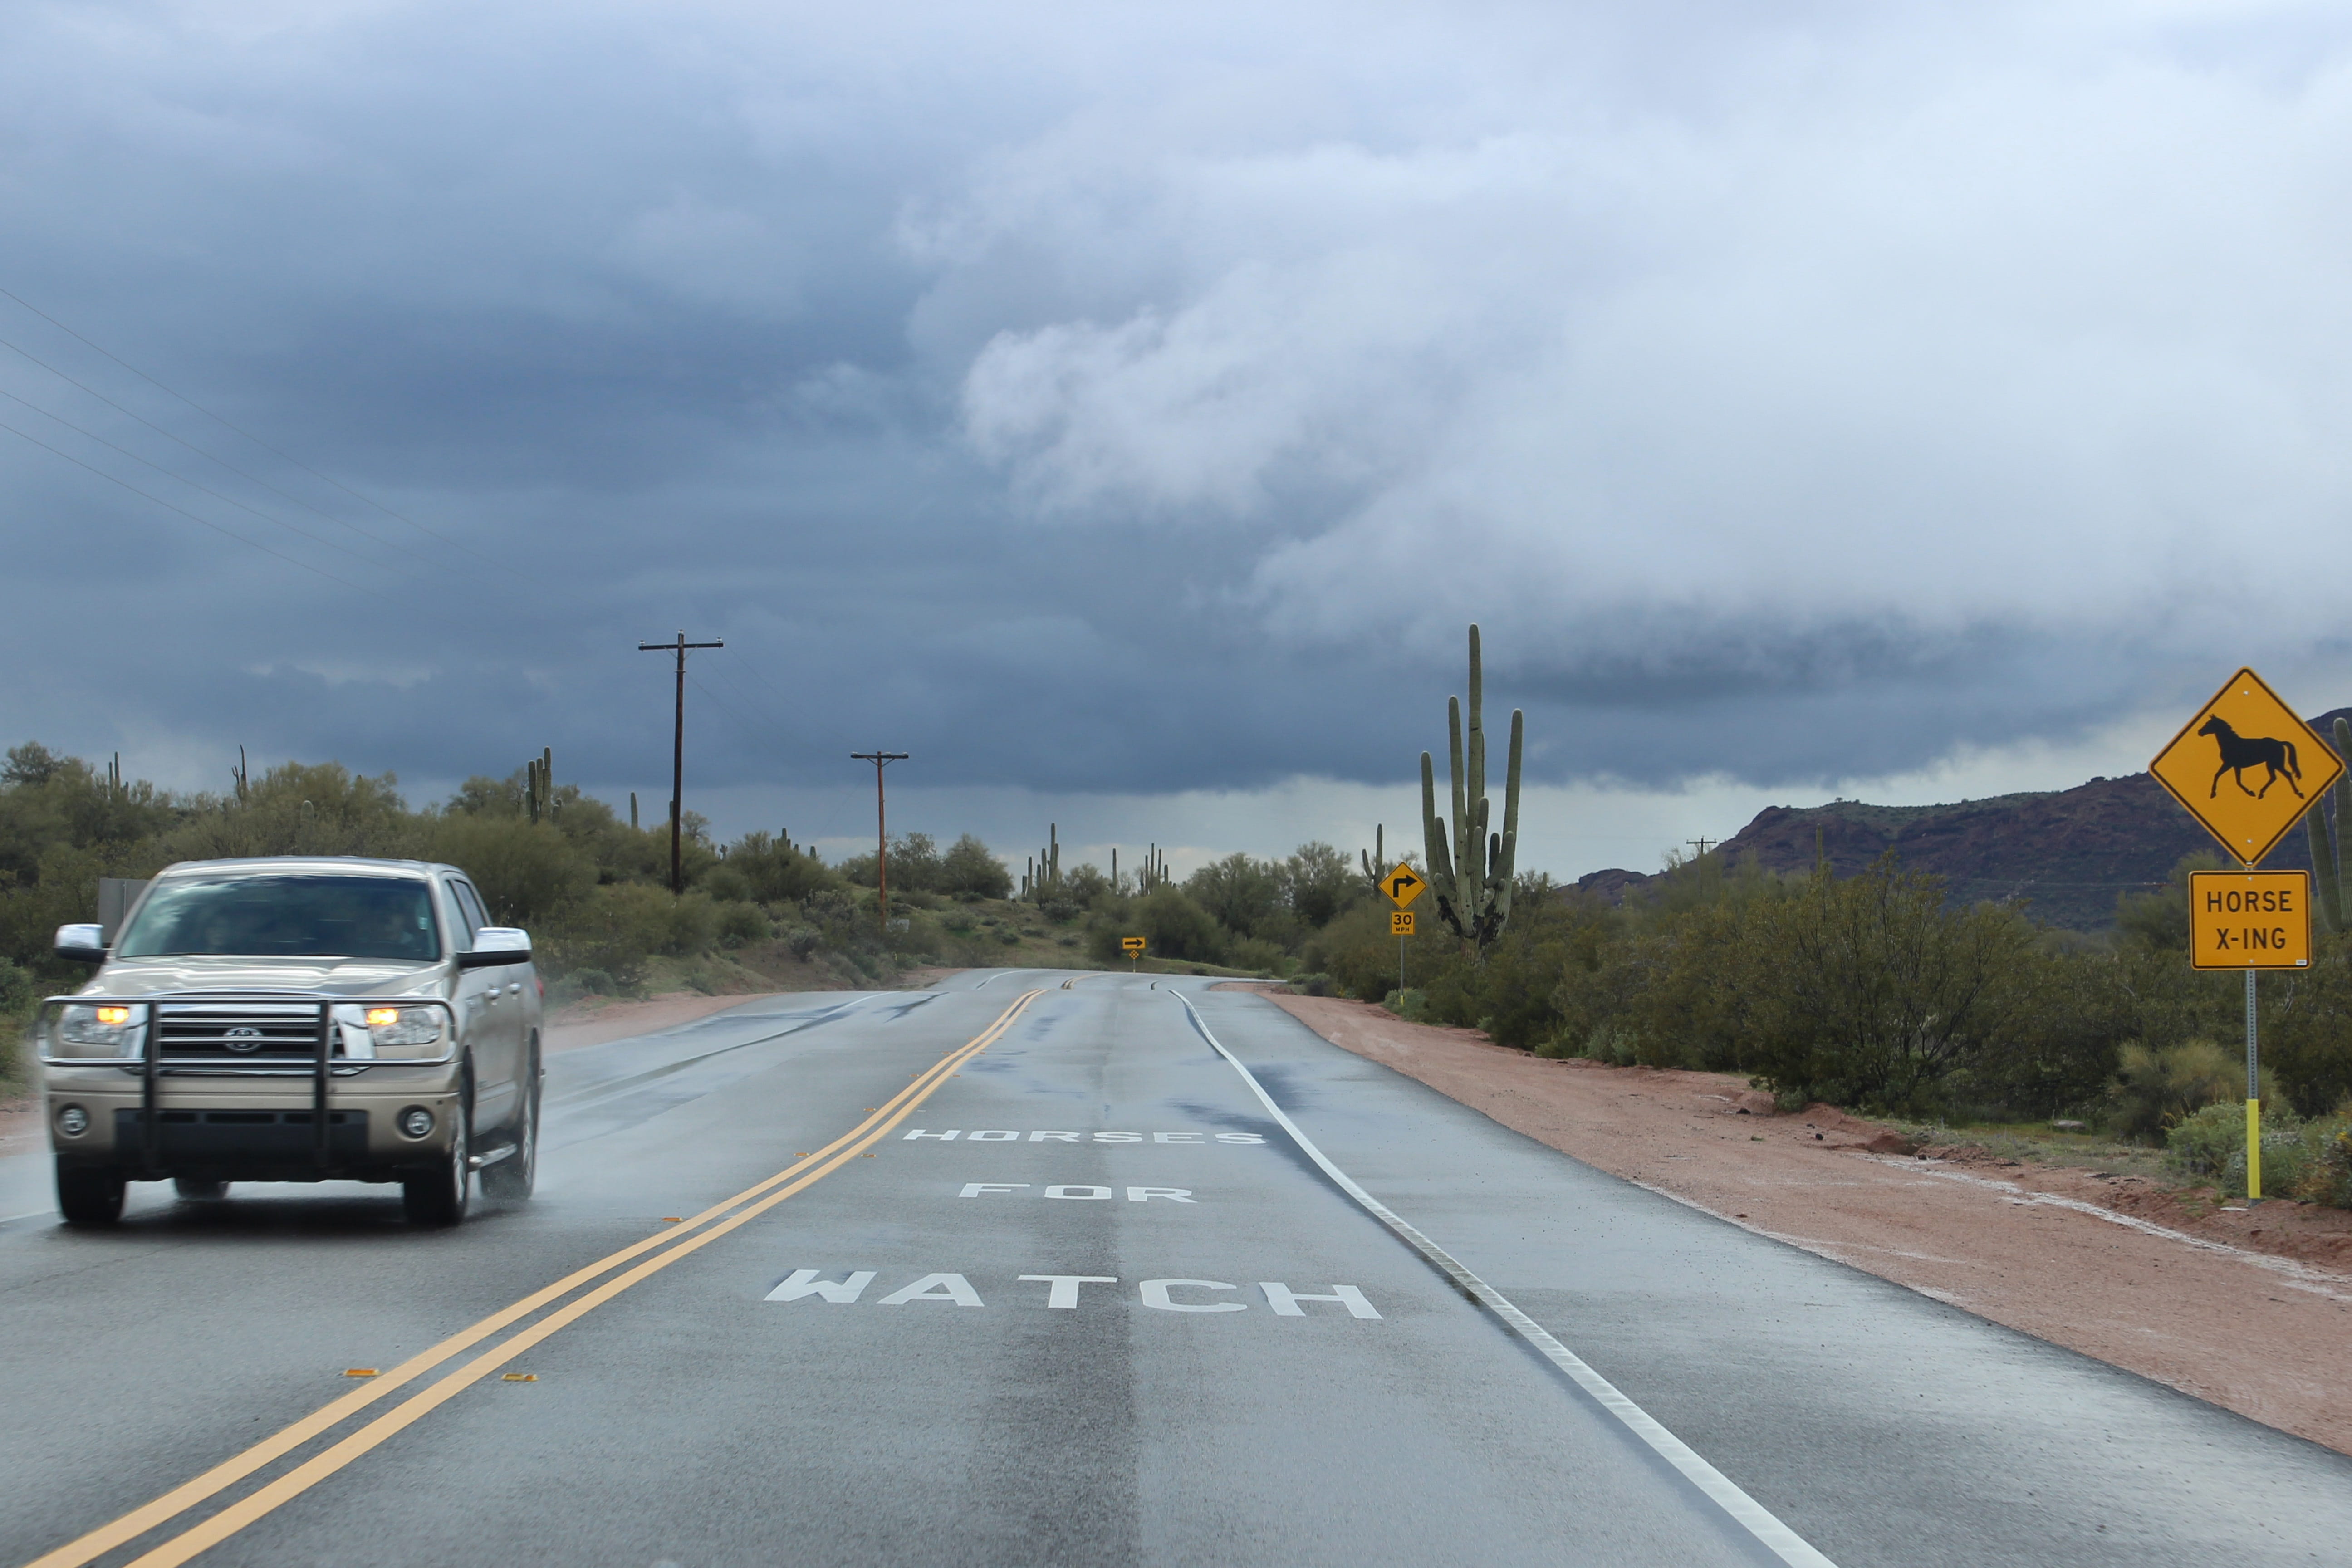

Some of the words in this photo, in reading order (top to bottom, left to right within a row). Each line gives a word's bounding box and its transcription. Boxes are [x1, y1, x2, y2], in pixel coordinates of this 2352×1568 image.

[2207, 890, 2293, 913] HORSE
[1393, 914, 1412, 925] 30
[2216, 927, 2286, 950] X-ING
[902, 1129, 1268, 1145] HORSES
[958, 1182, 1198, 1203] FOR
[764, 1269, 1384, 1320] WATCH
